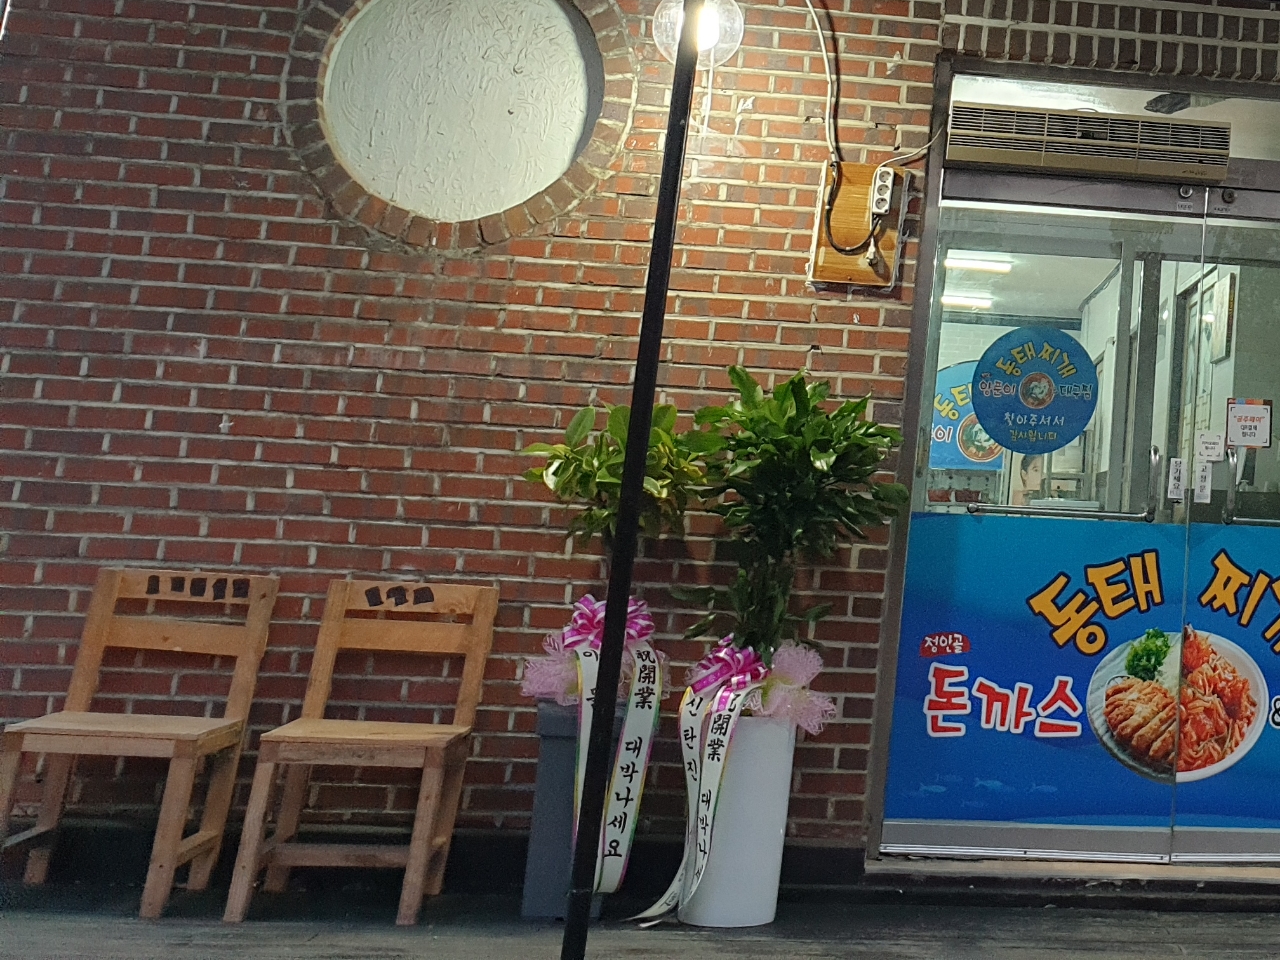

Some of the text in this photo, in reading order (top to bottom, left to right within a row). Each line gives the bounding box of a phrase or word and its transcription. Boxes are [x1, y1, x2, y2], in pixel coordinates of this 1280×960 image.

[995, 341, 1078, 378] 동태찌개
[1004, 411, 1065, 426] 찾아주셔서
[1027, 548, 1165, 656] 동태
[924, 633, 964, 654] 정안골
[634, 649, 656, 711] 祝開業
[923, 661, 1083, 738] 돈까스
[683, 696, 704, 782] 신탄진
[603, 736, 643, 858] 대박나세요
